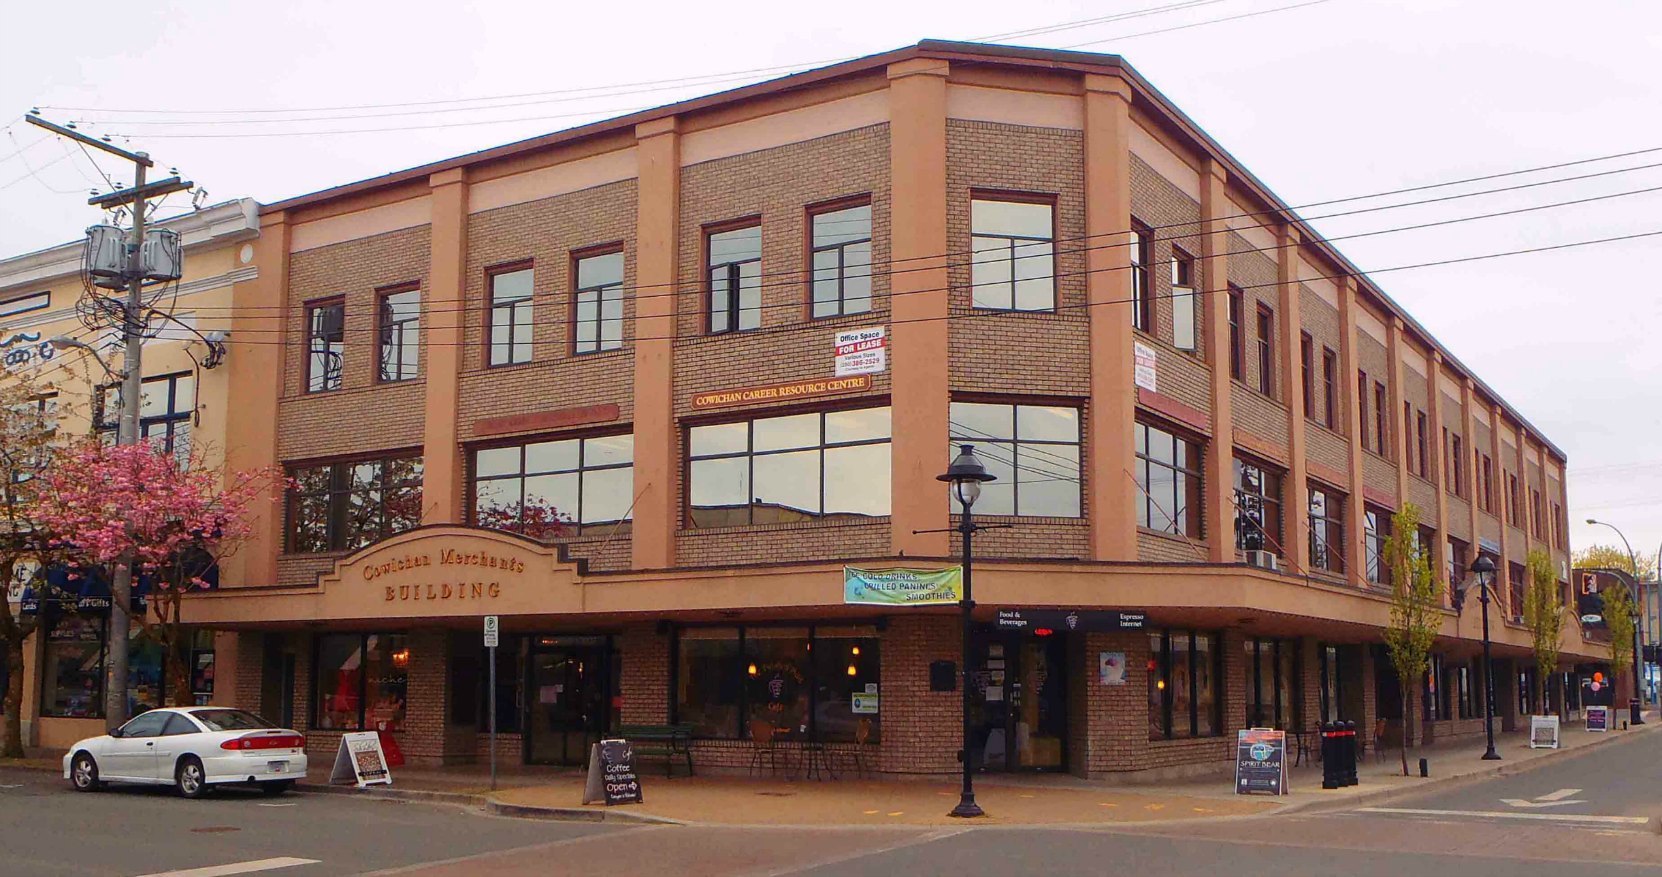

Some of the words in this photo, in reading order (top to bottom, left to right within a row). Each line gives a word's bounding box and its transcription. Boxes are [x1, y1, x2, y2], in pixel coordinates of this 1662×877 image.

[840, 334, 858, 342] Office
[860, 332, 880, 341] Space
[838, 345, 855, 354] FOR
[857, 339, 882, 350] LEASE
[696, 392, 742, 406] COWICHAN
[743, 388, 778, 401] CAREER
[779, 382, 827, 396] RESOURCE
[828, 377, 865, 391] CENTRE
[363, 554, 431, 581] Cowichan
[440, 548, 524, 573] Merchants
[863, 572, 885, 580] COLD
[385, 582, 501, 601] BUILDING
[906, 591, 956, 601] SMOOTHIES
[1120, 613, 1144, 621] Espresso
[606, 764, 630, 772] Coffee
[606, 783, 628, 793] Open
